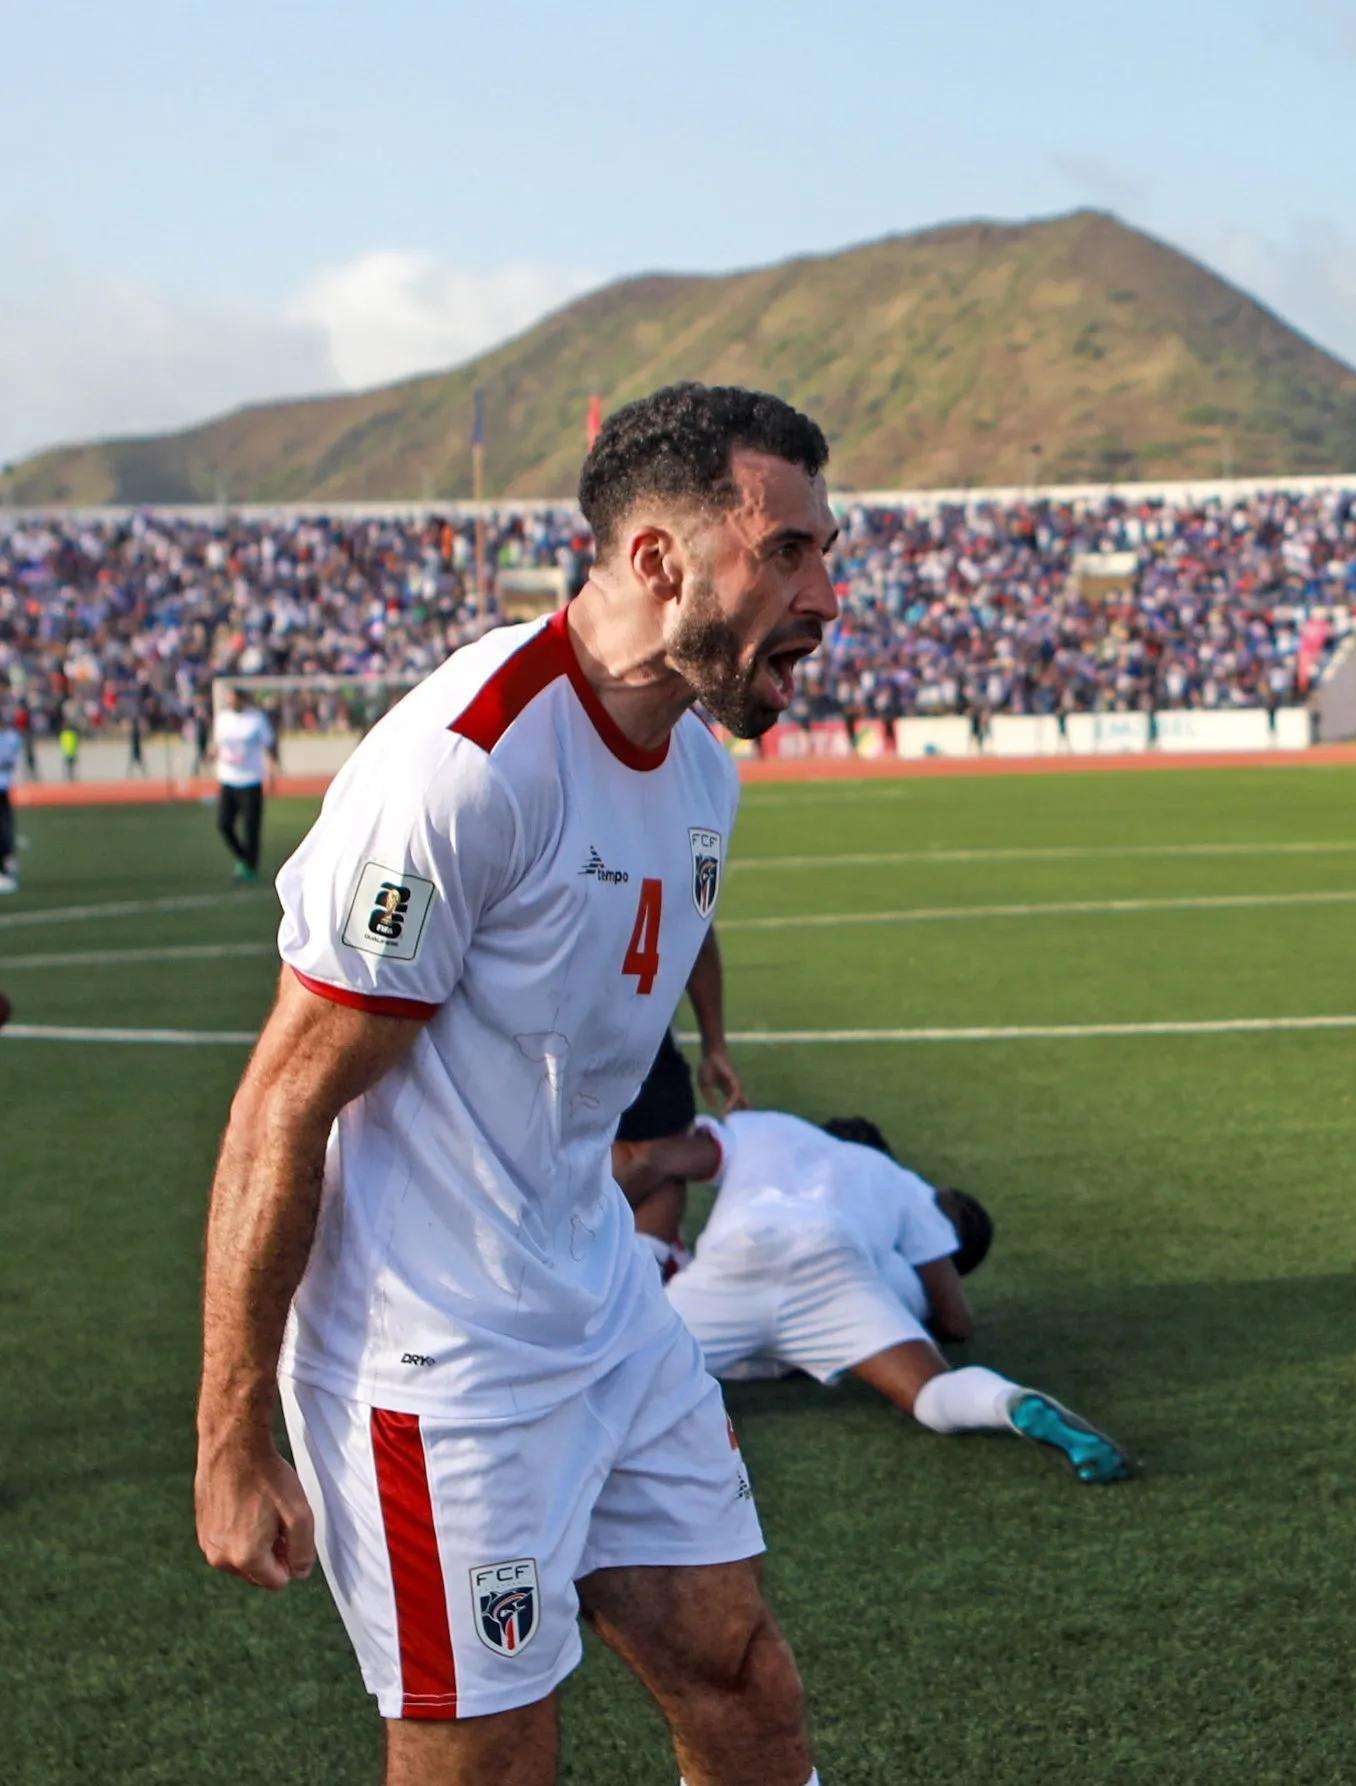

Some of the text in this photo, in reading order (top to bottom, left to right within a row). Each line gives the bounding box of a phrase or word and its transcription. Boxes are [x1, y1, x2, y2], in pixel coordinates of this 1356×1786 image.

[691, 832, 718, 848] FCF
[597, 868, 629, 885] tempo
[621, 877, 663, 995] 4
[476, 1564, 530, 1586] FCF
